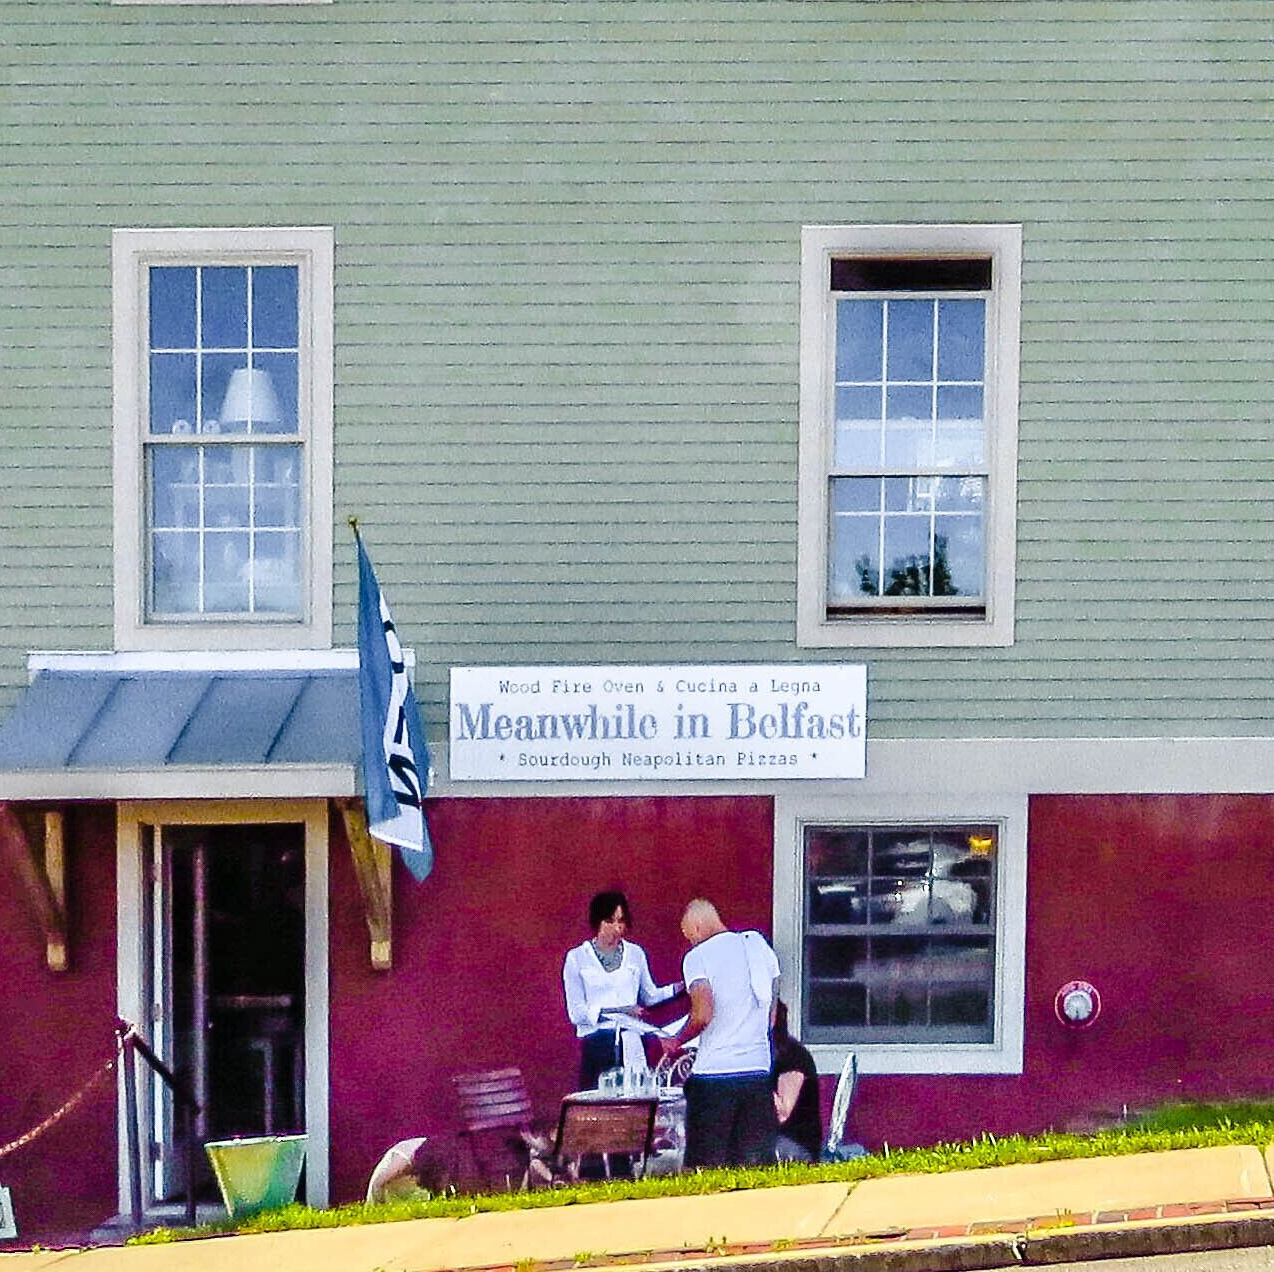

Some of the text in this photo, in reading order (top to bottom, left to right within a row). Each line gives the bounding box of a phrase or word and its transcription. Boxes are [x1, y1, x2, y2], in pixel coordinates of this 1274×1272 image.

[498, 679, 541, 694] Wood
[552, 679, 592, 694] Fire
[603, 679, 644, 693] Oven
[675, 677, 738, 693] Cucina
[748, 681, 759, 693] a
[771, 679, 821, 696] Legna
[455, 701, 861, 741] Meanwhile in Belfast
[518, 751, 798, 770] Sourdough Neapolitan Pizzas
